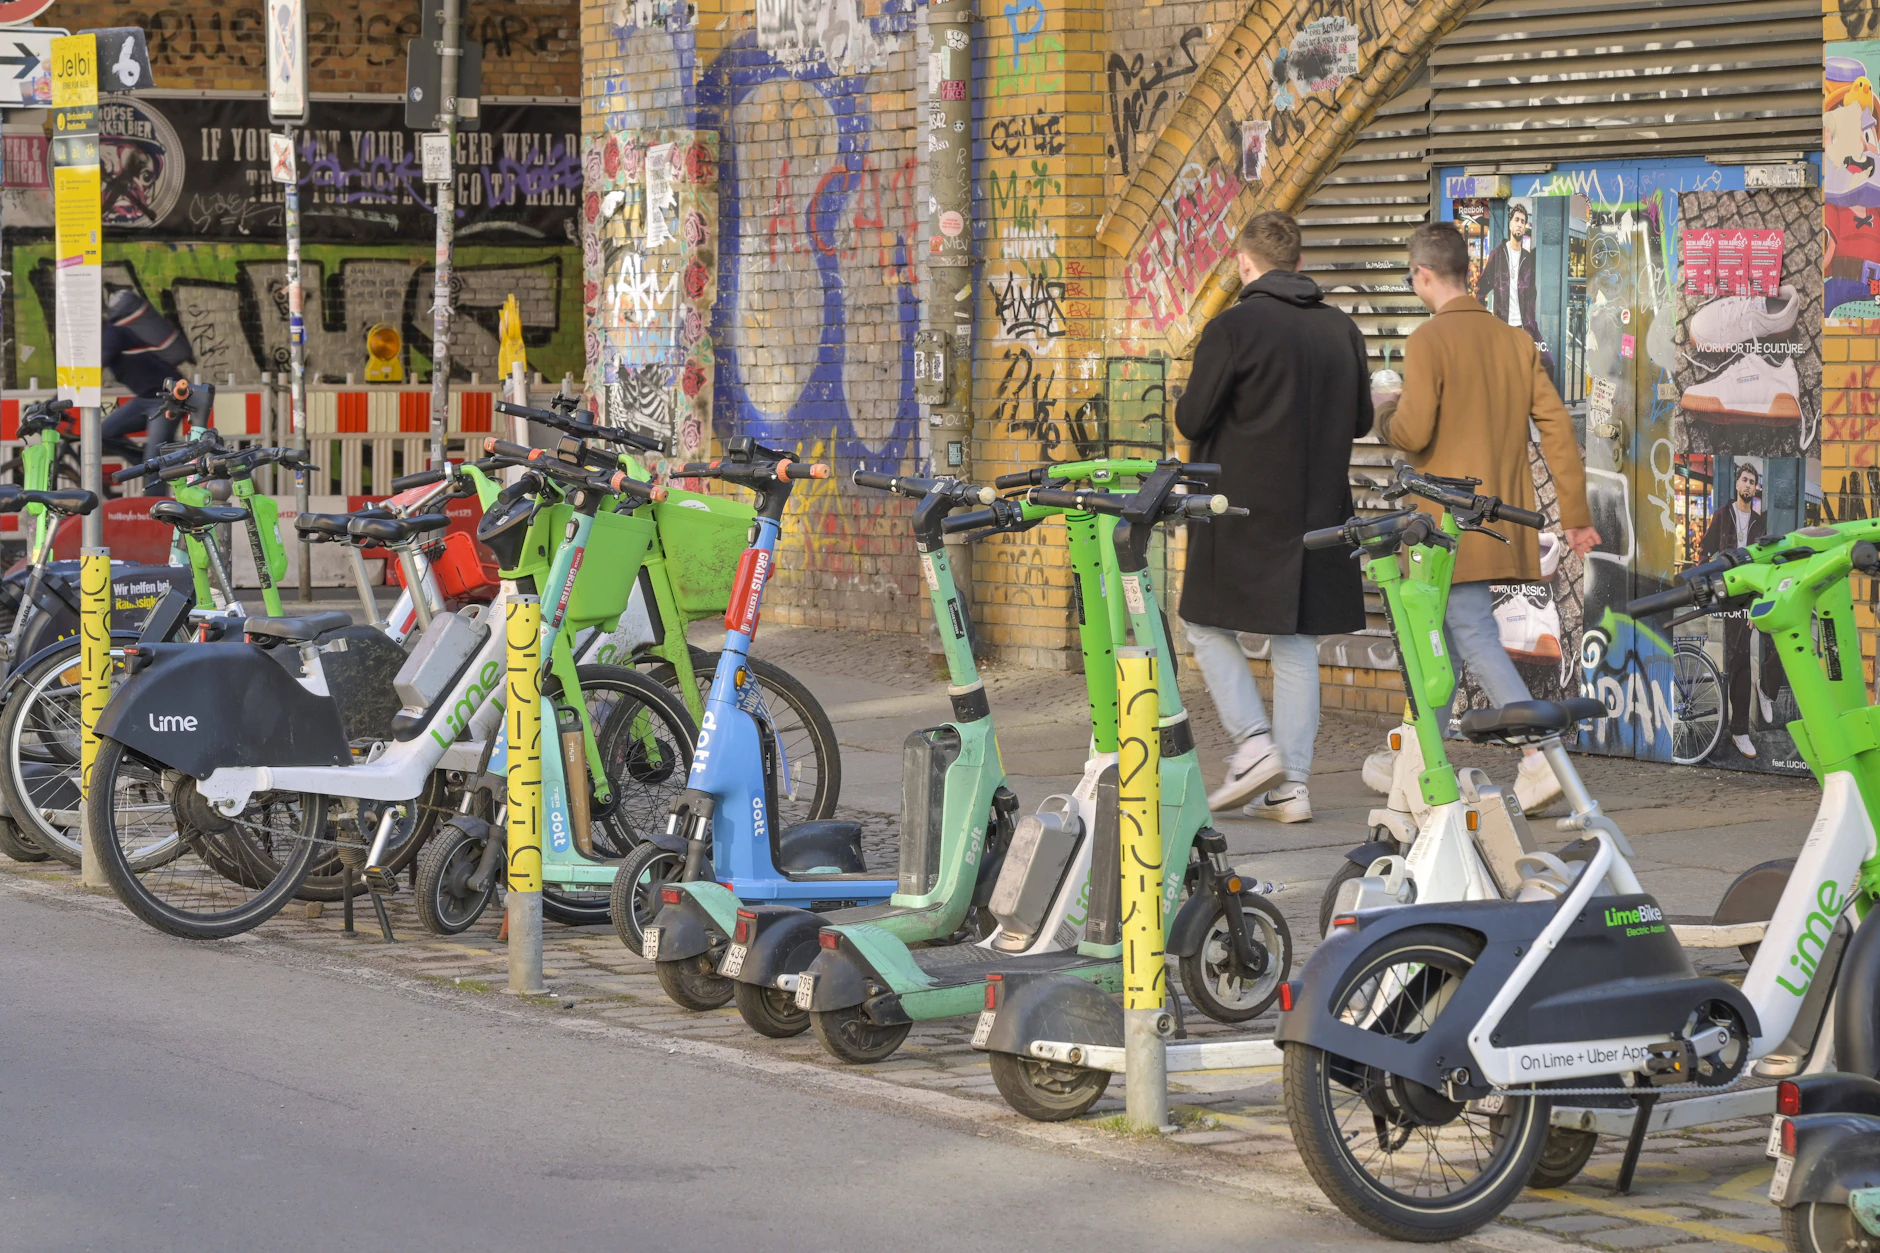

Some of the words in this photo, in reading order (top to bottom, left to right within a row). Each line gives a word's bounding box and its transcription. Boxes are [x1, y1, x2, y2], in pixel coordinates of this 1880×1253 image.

[57, 51, 91, 78] Jelbi
[128, 122, 152, 138] BIER
[201, 128, 221, 161] IF
[350, 130, 403, 163] YOUR
[503, 132, 556, 165] WELL
[458, 173, 482, 206] GO
[1458, 206, 1484, 214] Reebok
[1696, 343, 1726, 353] WORN
[1726, 343, 1744, 353] FOR
[1745, 343, 1762, 353] THE
[1763, 343, 1806, 354] CULTURE.
[751, 552, 769, 592] GRATIS
[113, 583, 129, 596] Wir
[130, 581, 156, 595] helfen
[157, 579, 169, 593] bei
[1511, 584, 1547, 596] CLASSIC.
[430, 661, 500, 749] Lime
[149, 713, 198, 732] Lime
[691, 711, 717, 774] dott
[1772, 759, 1786, 768] feat.
[753, 797, 765, 837] dott
[551, 812, 567, 847] dott
[965, 826, 982, 866] Bolt
[1163, 872, 1180, 915] Bolt
[1604, 904, 1662, 927] LimeBike
[645, 931, 657, 943] 375
[1626, 926, 1650, 937] Electric
[1776, 880, 1844, 997] Lime
[731, 947, 745, 959] 434
[799, 976, 811, 991] 795
[1521, 1055, 1540, 1070] On
[1542, 1053, 1574, 1068] Lime
[1577, 1053, 1584, 1062] +
[1587, 1048, 1618, 1064] Uber
